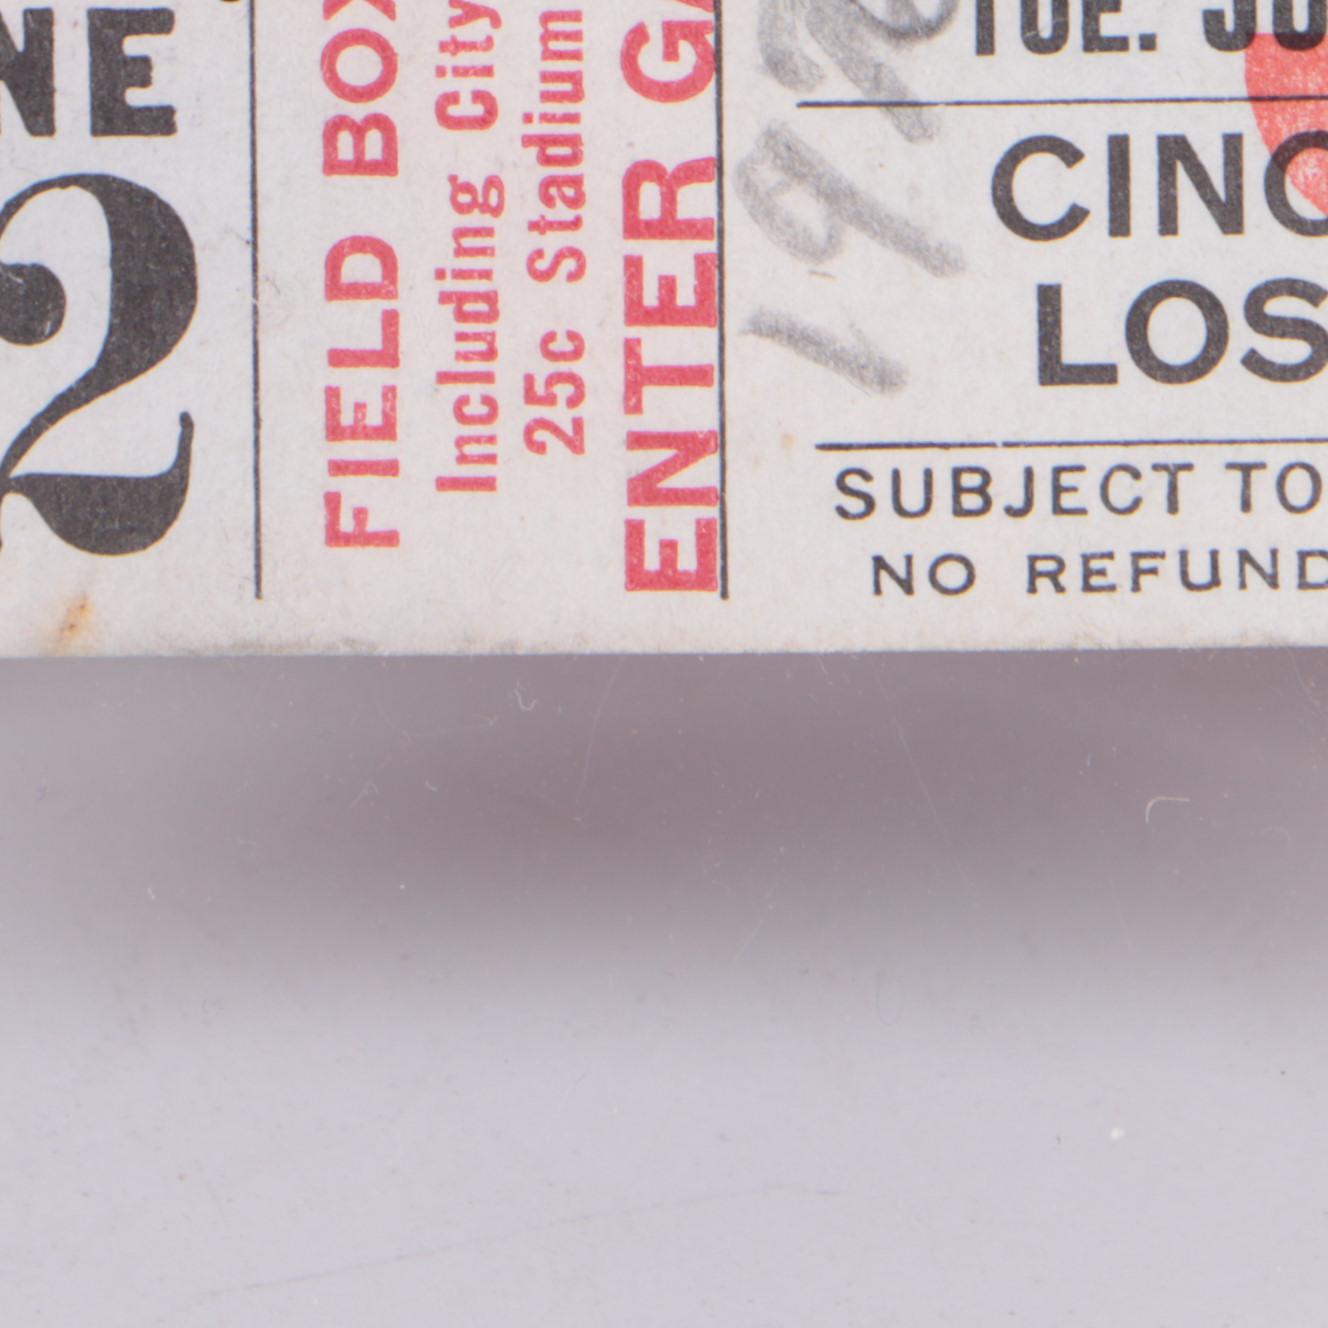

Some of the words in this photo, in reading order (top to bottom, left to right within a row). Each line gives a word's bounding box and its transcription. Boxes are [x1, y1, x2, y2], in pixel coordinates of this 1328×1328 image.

[521, 10, 587, 283] Stadium
[324, 235, 401, 548] FIELD
[435, 175, 506, 492] Including
[524, 330, 586, 455] 25c
[622, 156, 720, 592] ENTER
[837, 467, 1192, 518] SUBJECT
[1229, 464, 1319, 511] TO
[874, 556, 973, 593] NO
